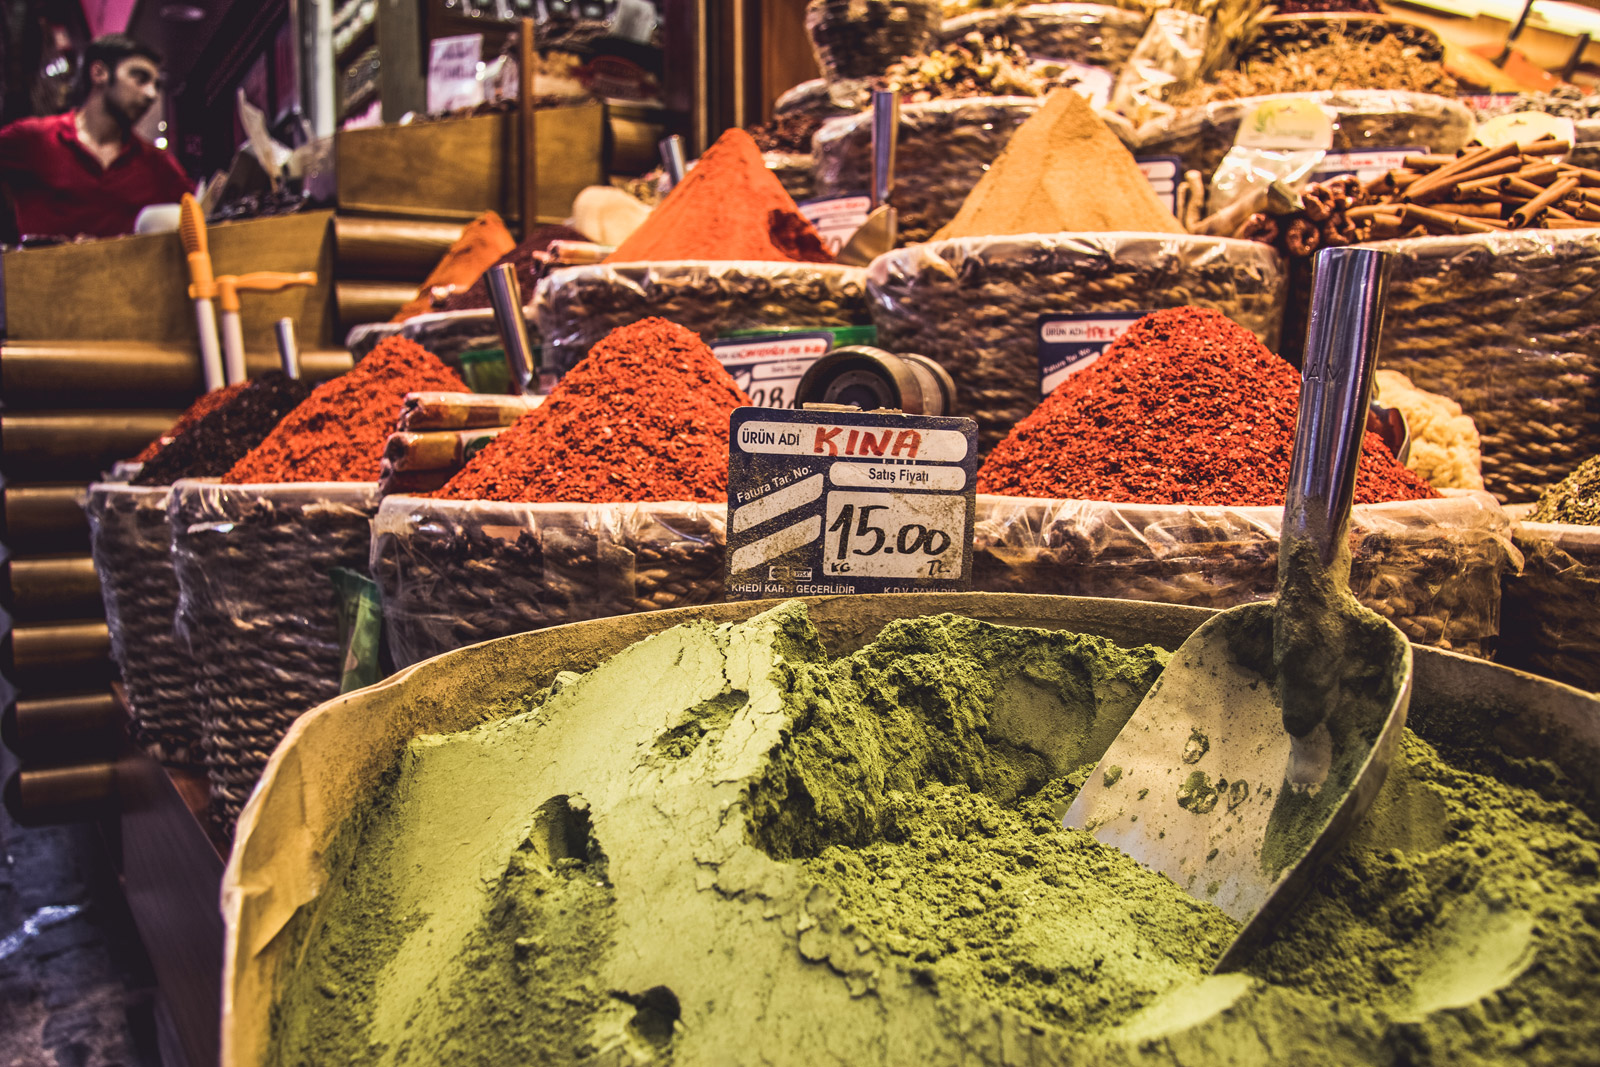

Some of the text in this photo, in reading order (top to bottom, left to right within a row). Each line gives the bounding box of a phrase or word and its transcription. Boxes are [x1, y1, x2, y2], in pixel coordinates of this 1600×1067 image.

[742, 427, 800, 446] ÜRÜN ADI
[813, 426, 922, 459] KINA
[736, 465, 813, 503] Fatura Tar. No:
[868, 467, 929, 483] Satış Fiyatı
[828, 504, 952, 560] 15.00
[831, 559, 951, 576] KG TL
[731, 582, 855, 595] KREDİ KAR GEÇERLİDİR
